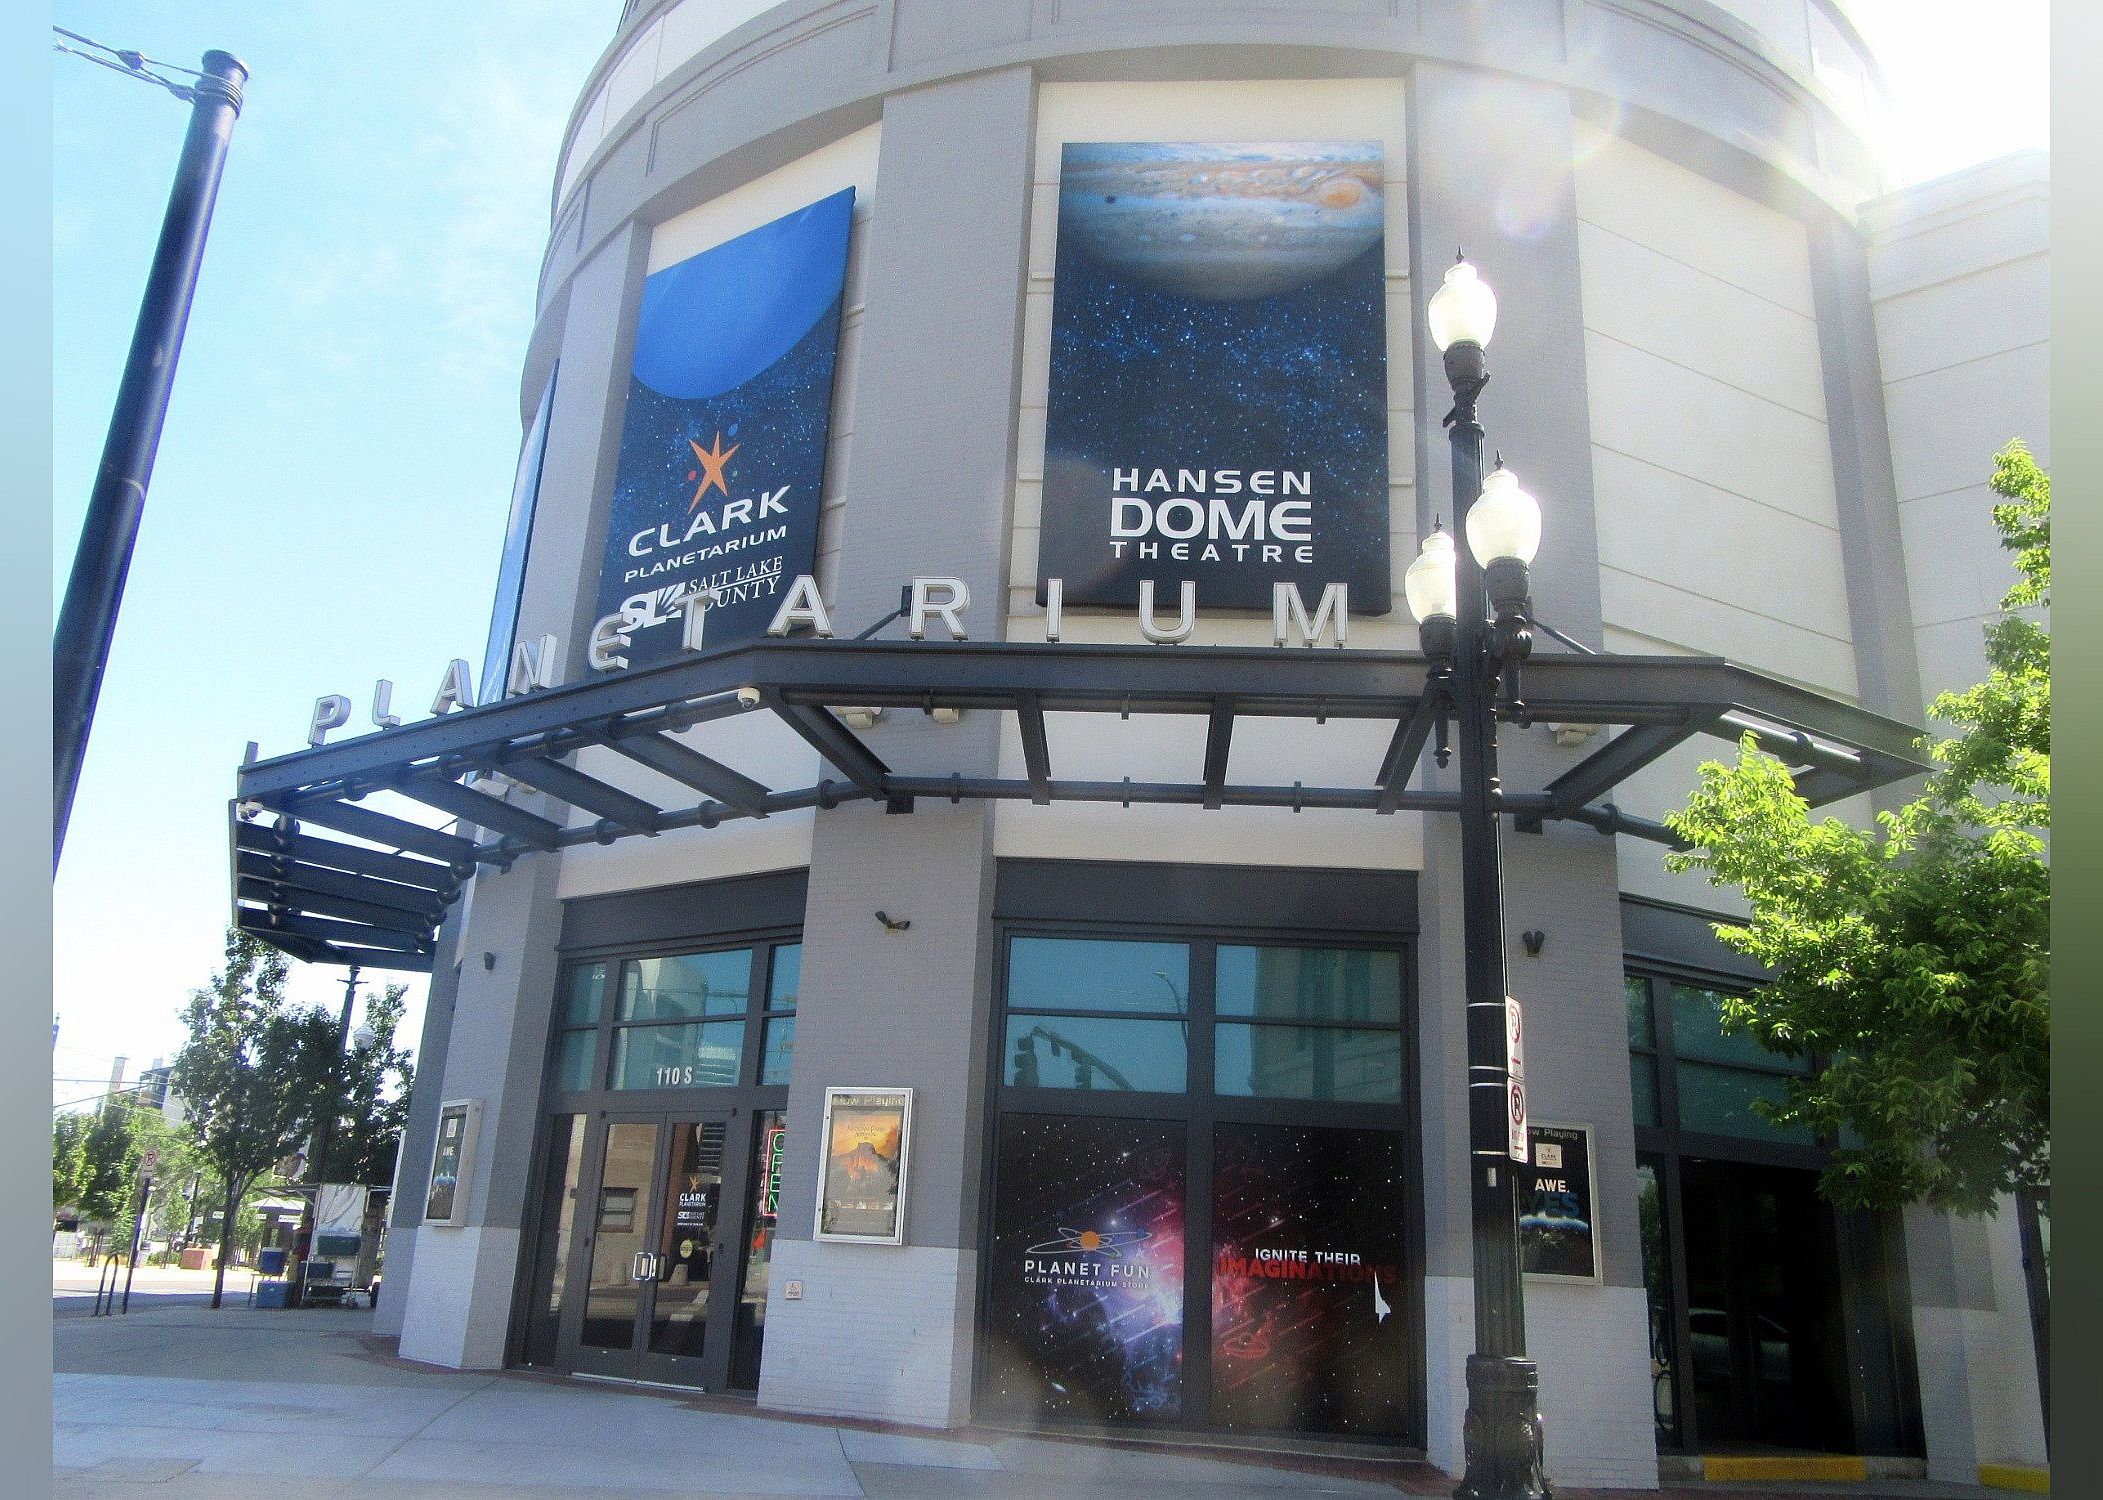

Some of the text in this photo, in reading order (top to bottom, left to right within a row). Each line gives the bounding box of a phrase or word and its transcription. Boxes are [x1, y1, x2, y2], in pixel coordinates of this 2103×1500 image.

[1113, 468, 1311, 495] HANSEN
[628, 485, 791, 557] CLARK
[1110, 498, 1312, 542] DOME
[624, 526, 787, 582] PLANETARIUM
[1109, 541, 1313, 564] THEATRE
[688, 556, 783, 594] SALT LAKE
[656, 1066, 692, 1085] 110 S
[1544, 1128, 1578, 1140] Playing
[679, 1193, 706, 1202] CLARK
[1255, 1248, 1361, 1266] IGNITE THEIR
[1024, 1260, 1150, 1279] PLANET FUN
[1024, 1276, 1053, 1284] CLARK
[1056, 1278, 1118, 1287] PLANETARIUM
